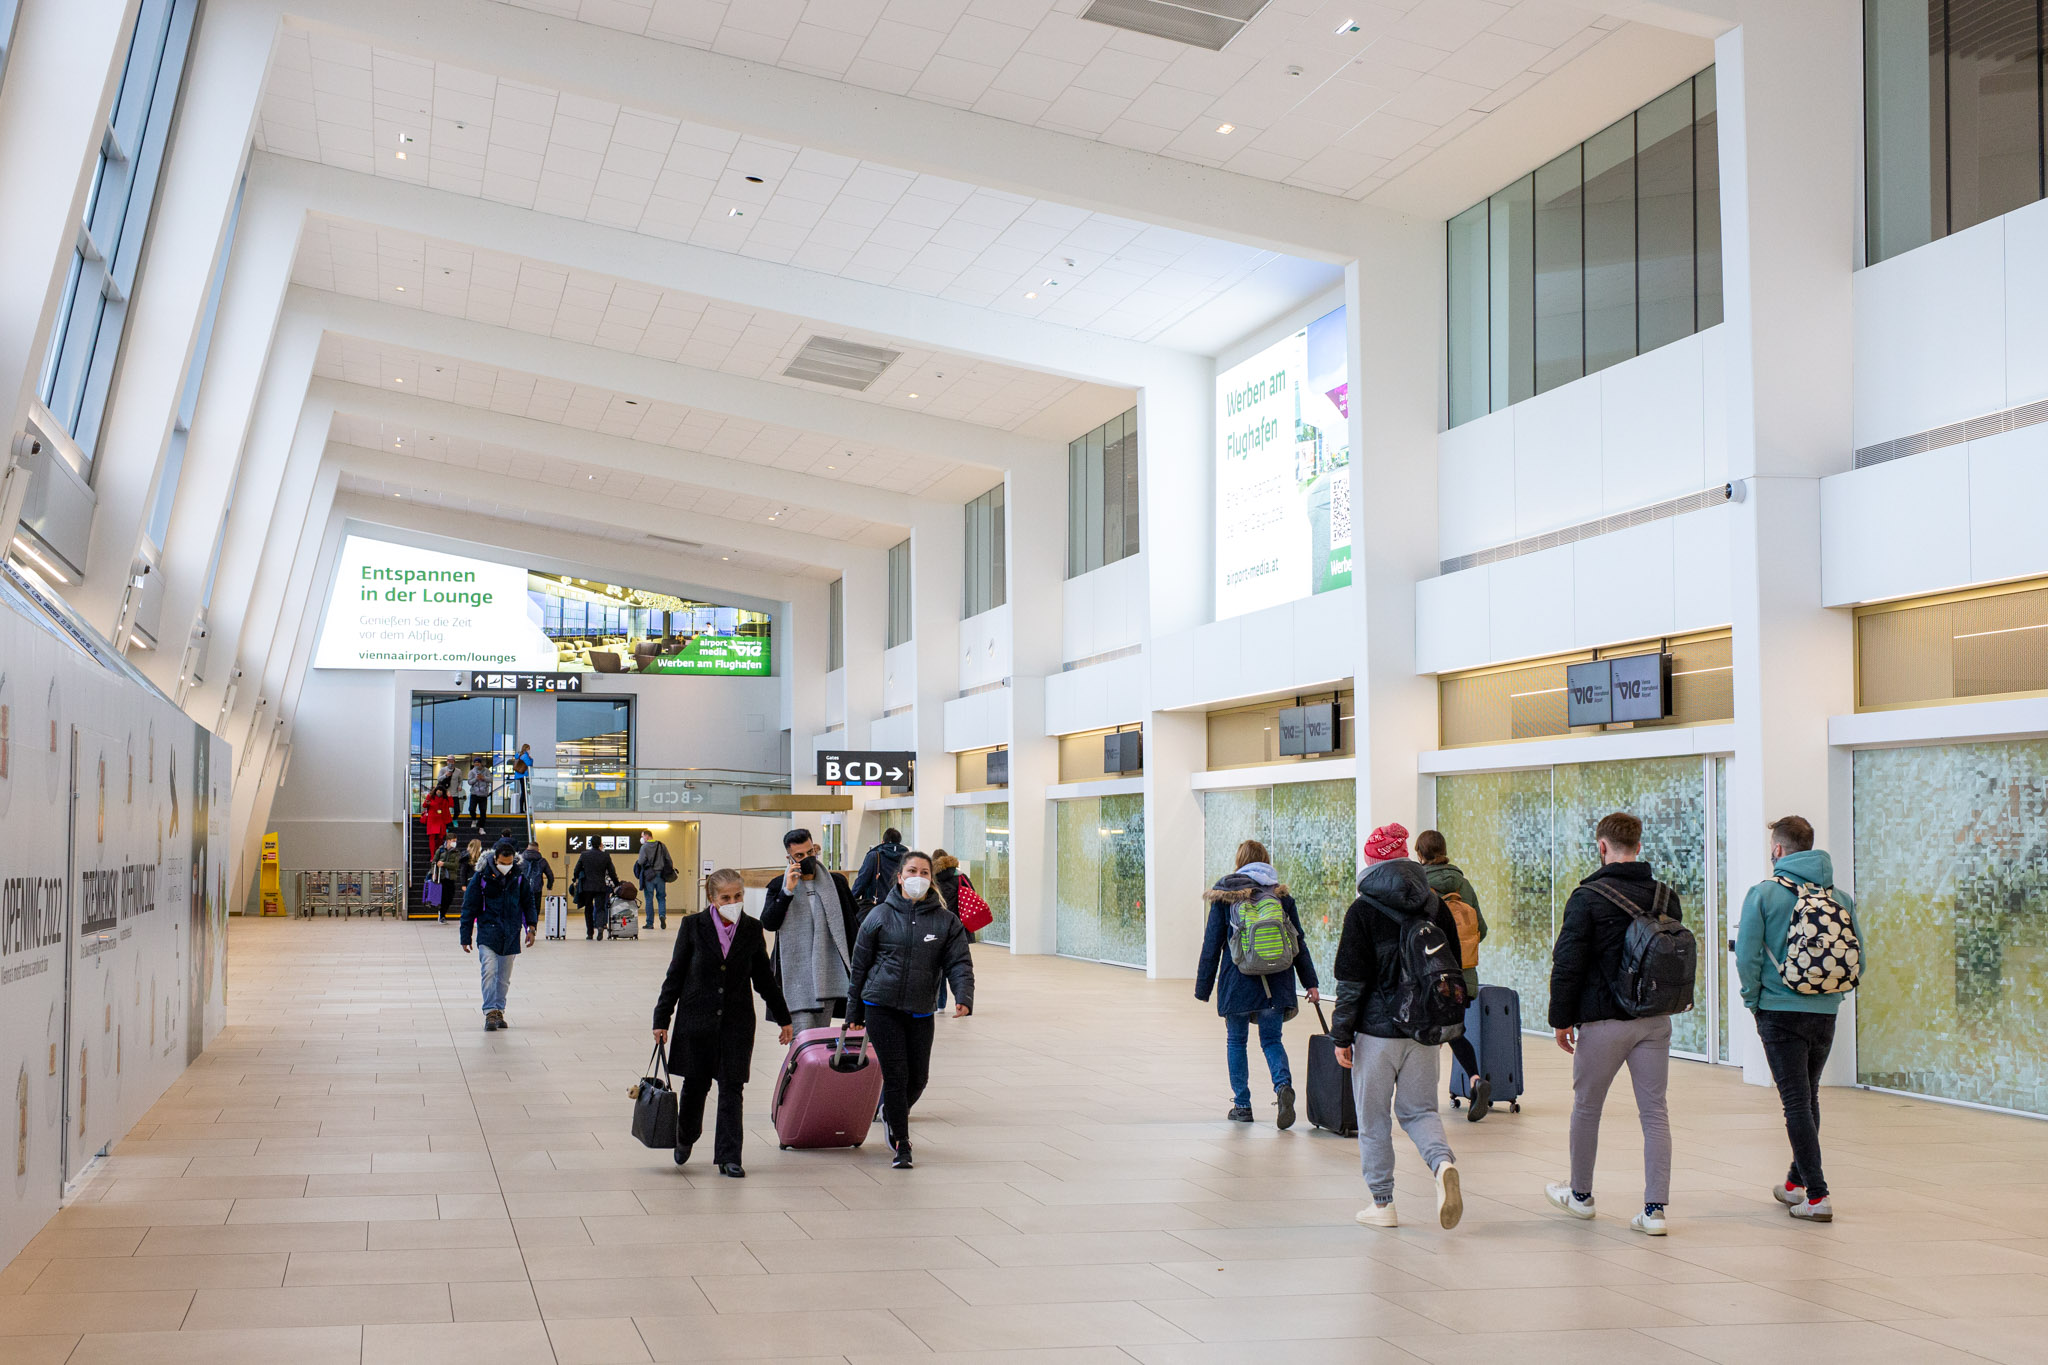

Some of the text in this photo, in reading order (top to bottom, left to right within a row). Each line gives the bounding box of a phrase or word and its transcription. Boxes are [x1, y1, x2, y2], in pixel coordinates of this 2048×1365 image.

[1227, 369, 1286, 417] Werben am
[1227, 415, 1278, 461] Flughafen
[361, 565, 476, 585] Entspannen
[361, 585, 494, 608] in der Lounge
[359, 615, 472, 628] Genießen Sie die Zeit
[359, 630, 377, 640] vor
[380, 630, 405, 641] dem
[700, 638, 728, 648] airport
[359, 650, 517, 665] viennaairport.com/lounges
[699, 648, 728, 656] media
[657, 658, 695, 668] Werben
[715, 660, 762, 671] Flughafen
[527, 680, 554, 689] 3 F G
[826, 762, 883, 781] B C D
[2, 876, 63, 957] OPENING 2022
